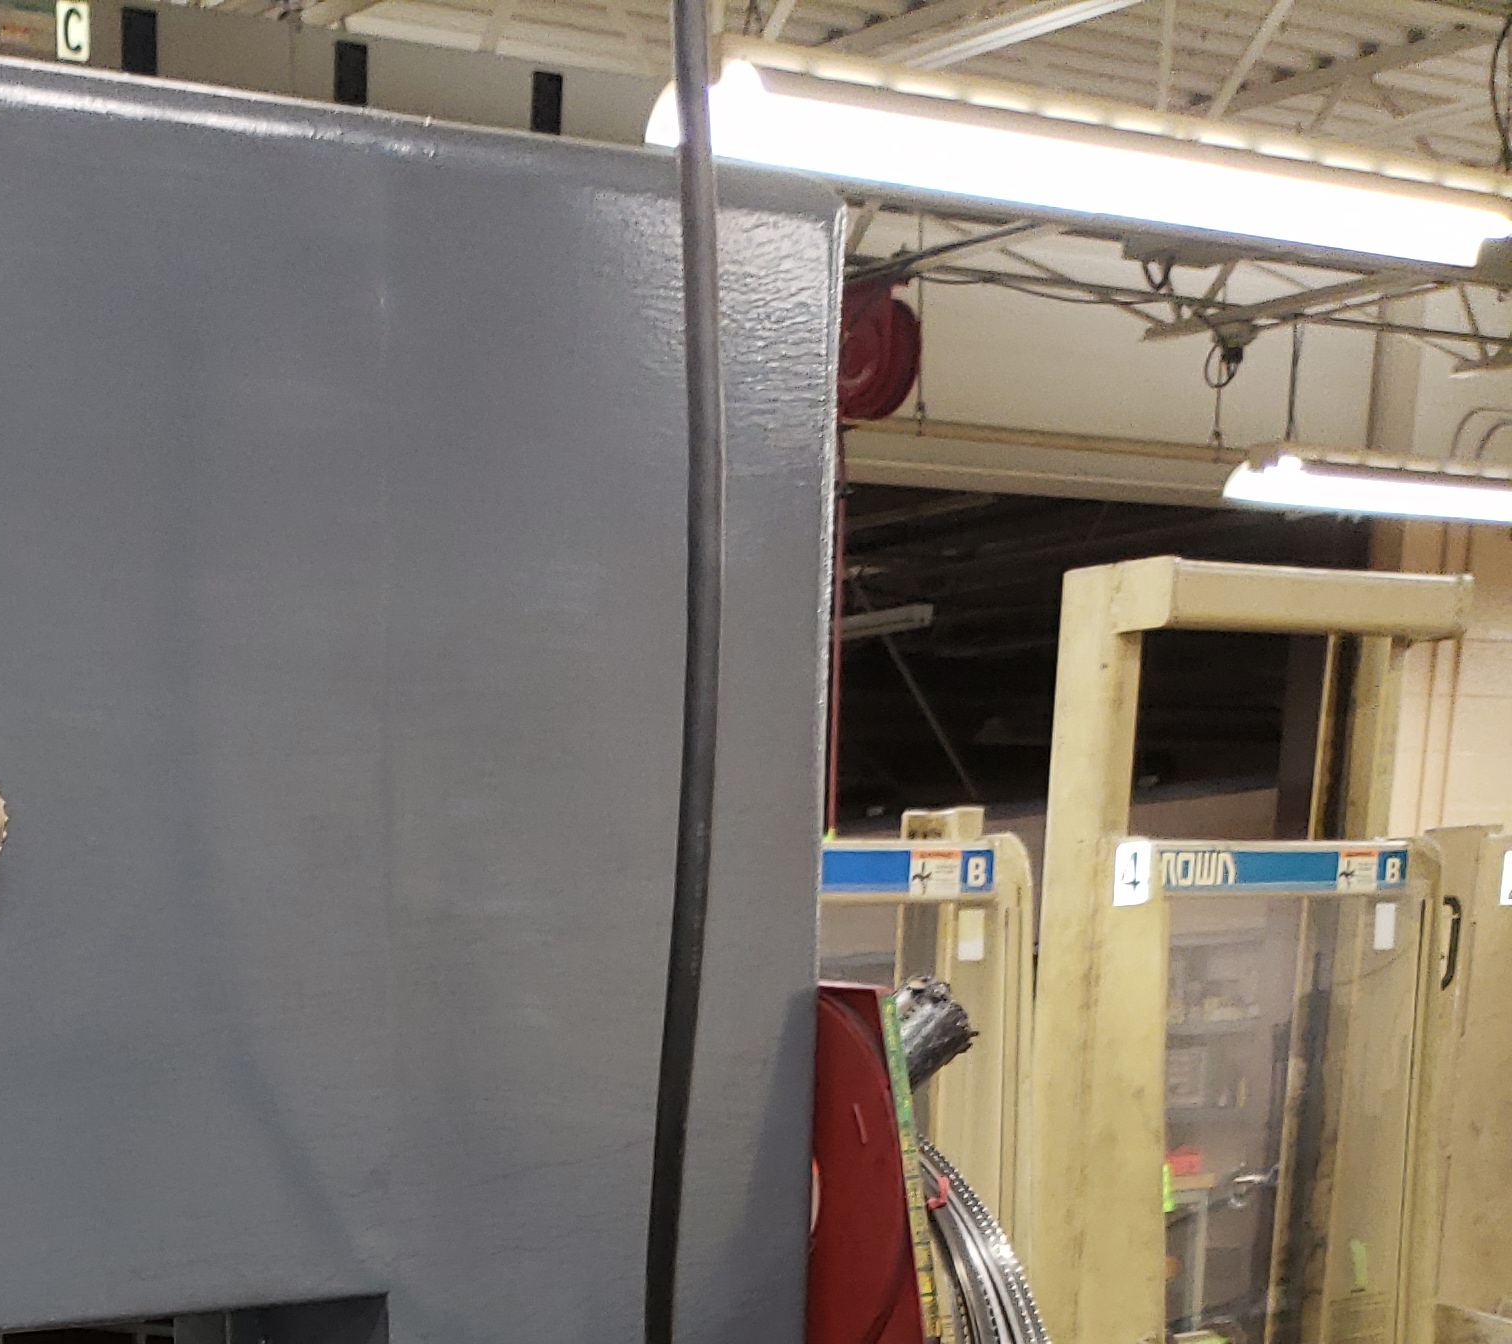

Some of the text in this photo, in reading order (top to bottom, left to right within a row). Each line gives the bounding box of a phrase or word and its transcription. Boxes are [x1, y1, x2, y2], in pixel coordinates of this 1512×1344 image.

[64, 7, 82, 53] C
[967, 855, 987, 888] B
[1385, 857, 1402, 884] B
